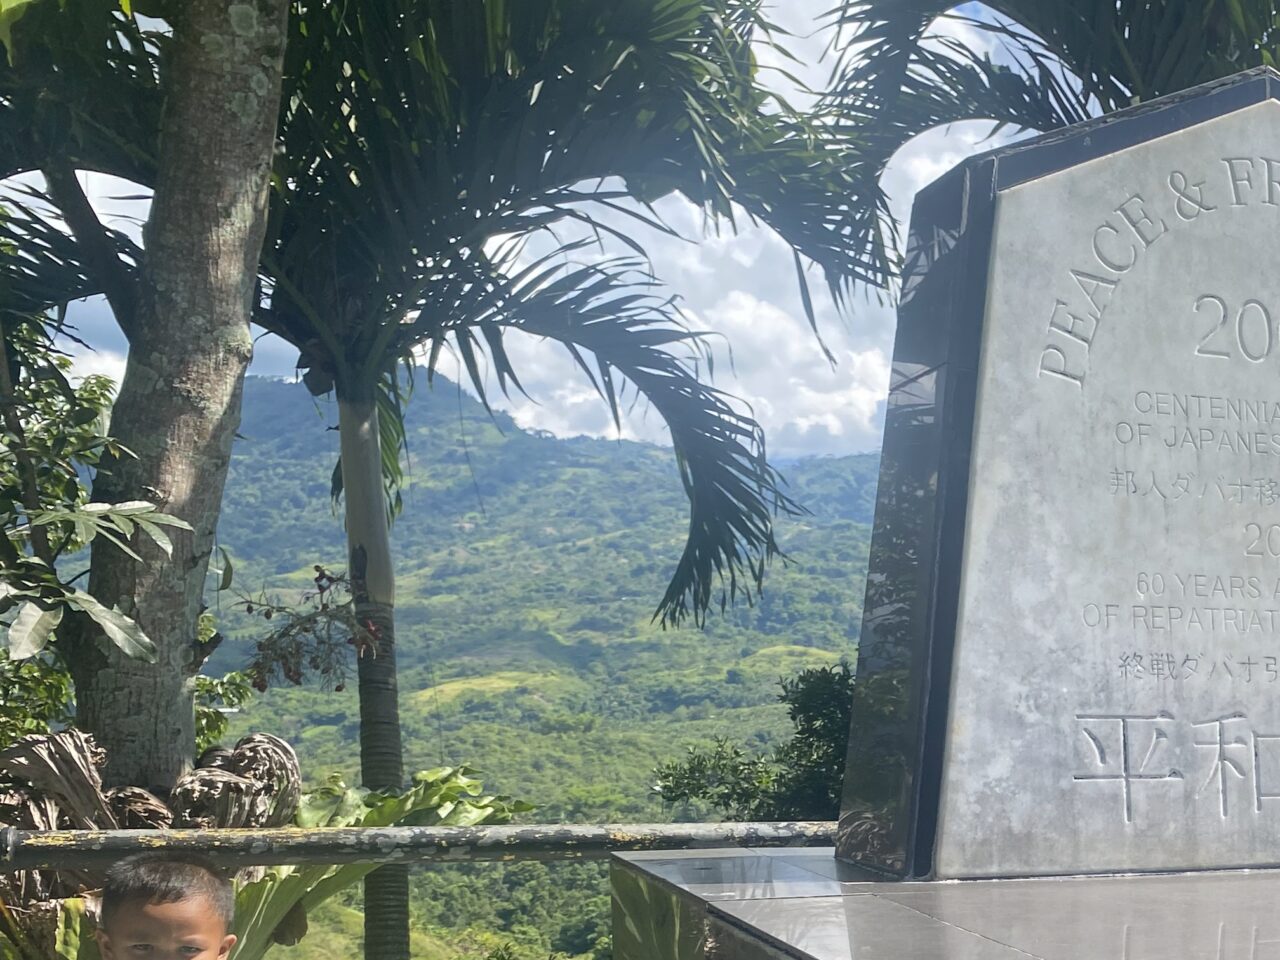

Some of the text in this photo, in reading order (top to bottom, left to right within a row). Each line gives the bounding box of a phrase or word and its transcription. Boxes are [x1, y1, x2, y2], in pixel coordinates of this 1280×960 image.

[1037, 194, 1169, 390] PEACE
[1168, 169, 1218, 222] &
[1115, 422, 1152, 445] OF
[1137, 572, 1166, 597] 60
[1174, 574, 1262, 600] YEARS
[1082, 603, 1120, 630] OF
